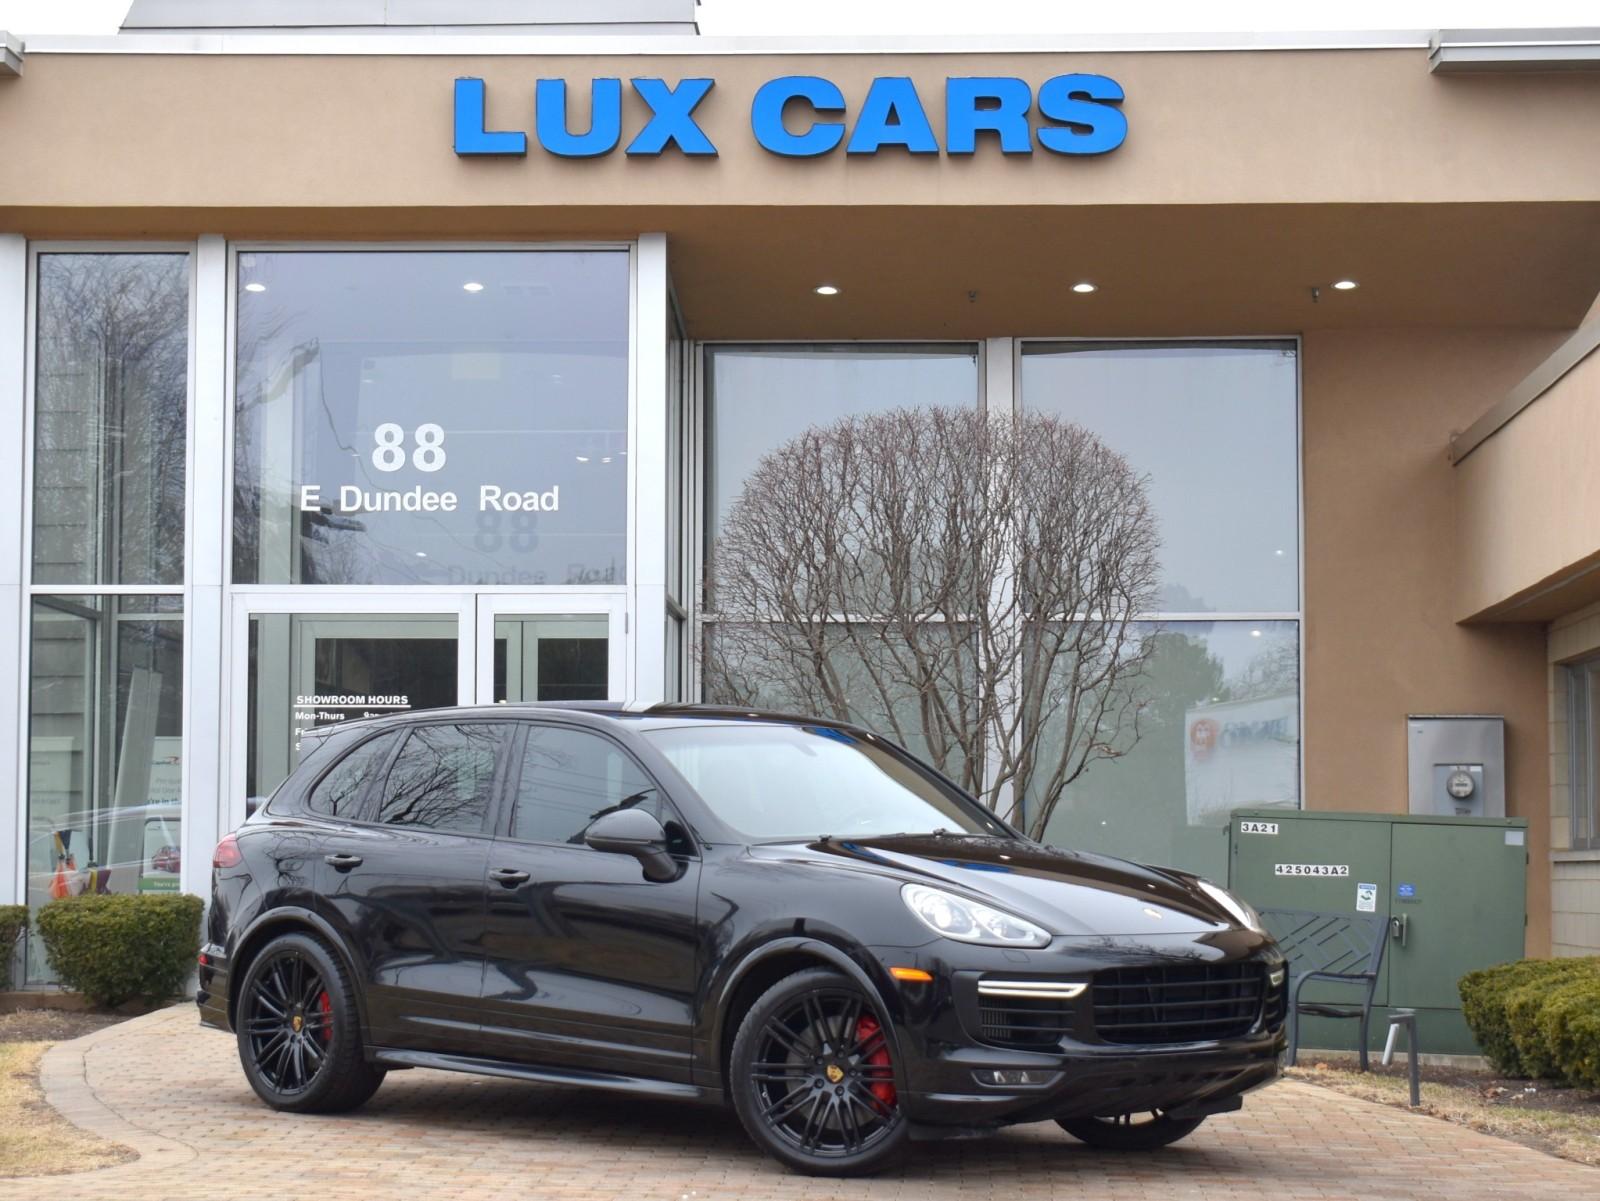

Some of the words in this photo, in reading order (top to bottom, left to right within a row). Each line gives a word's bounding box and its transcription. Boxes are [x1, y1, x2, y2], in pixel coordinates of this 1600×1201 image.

[454, 78, 718, 158] LUX
[751, 73, 1128, 158] CARS
[372, 423, 446, 472] 88
[300, 485, 320, 511] E
[340, 485, 457, 511] Dundee
[479, 485, 559, 511] Road
[296, 695, 366, 704] SHOWROOM
[368, 695, 408, 704] HOURS
[295, 711, 345, 720] Mon-Thurs
[1242, 823, 1276, 833] 3A21
[1276, 865, 1347, 875] 425043A2
